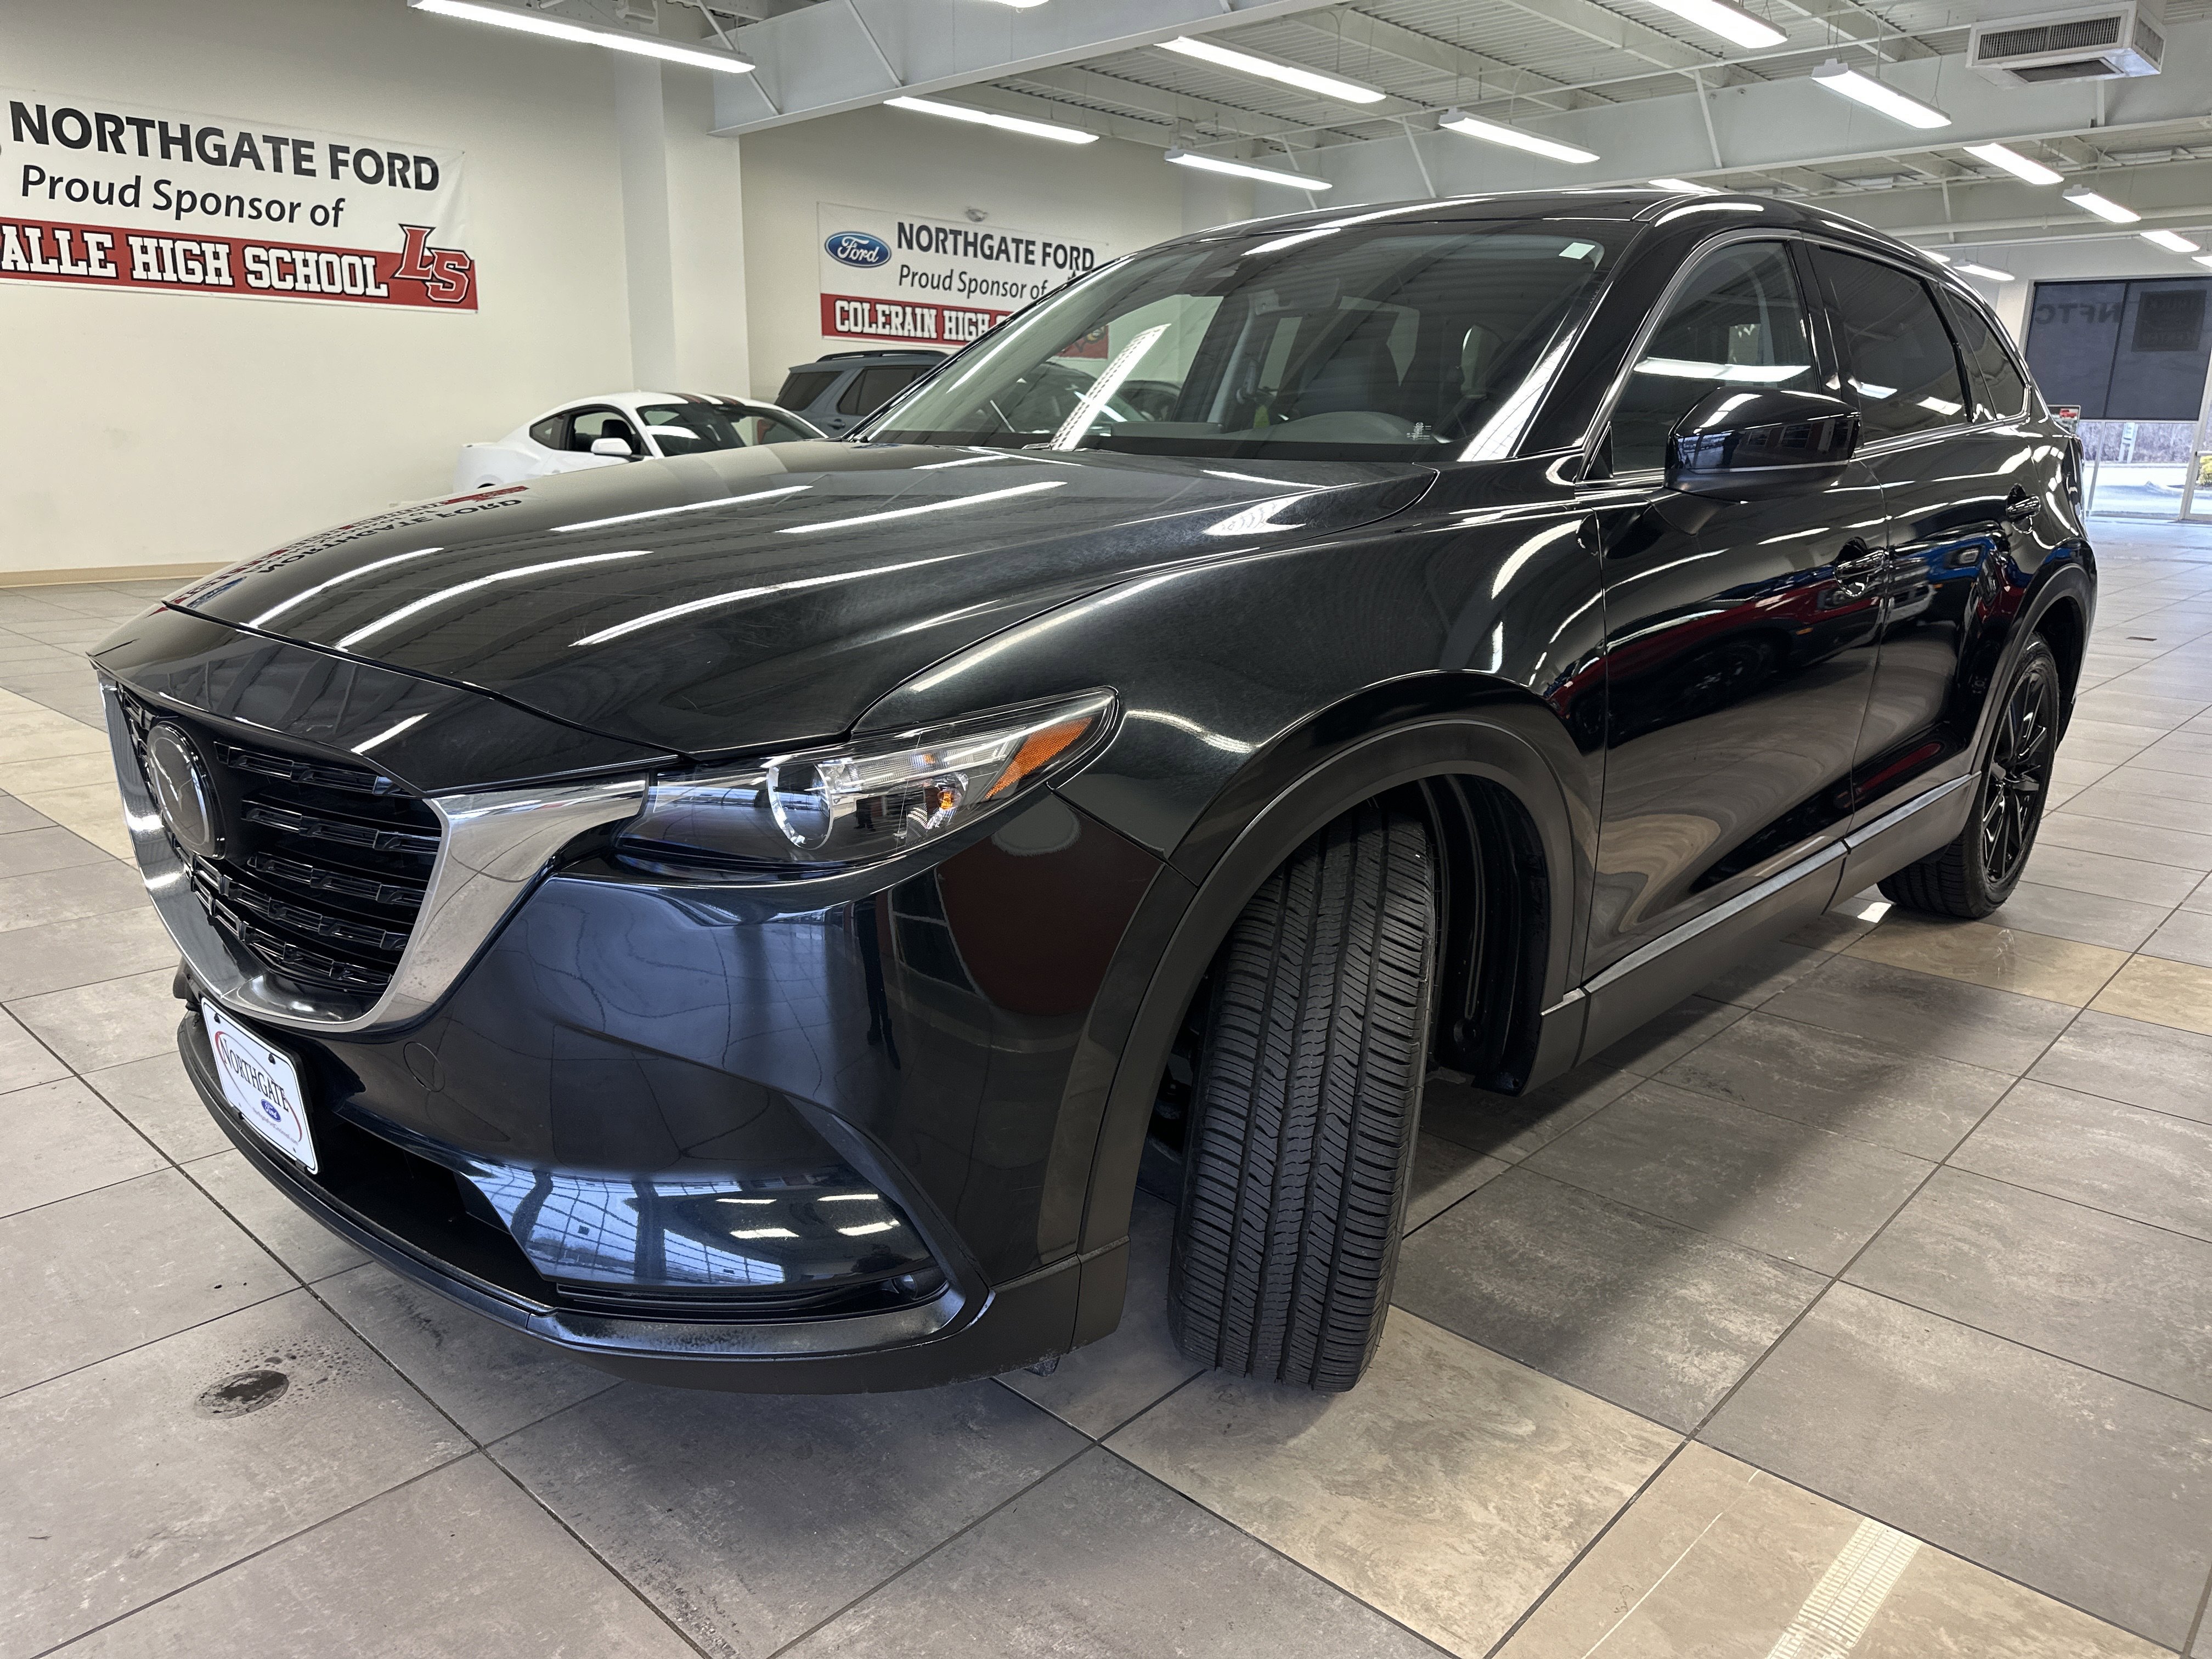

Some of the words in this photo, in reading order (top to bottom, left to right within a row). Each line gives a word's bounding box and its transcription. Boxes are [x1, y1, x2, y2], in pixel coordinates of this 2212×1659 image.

[9, 100, 317, 177] NORTHGATE
[329, 144, 439, 191] FORD
[21, 164, 142, 208] Proud
[152, 179, 301, 223] Sponsor
[311, 198, 345, 228] of
[128, 236, 234, 286] HIGH
[244, 246, 389, 297] SCHOOL
[390, 223, 470, 303] LS
[837, 236, 881, 262] Ford
[897, 222, 1035, 265] NORTHGATE
[1042, 242, 1094, 272] FORD
[899, 264, 954, 291] Proud
[957, 271, 1027, 299] Sponsor
[1030, 280, 1048, 300] of
[834, 300, 937, 339] COLERAIN
[943, 311, 991, 341] HIGH
[219, 1038, 289, 1113] NORTHGATE
